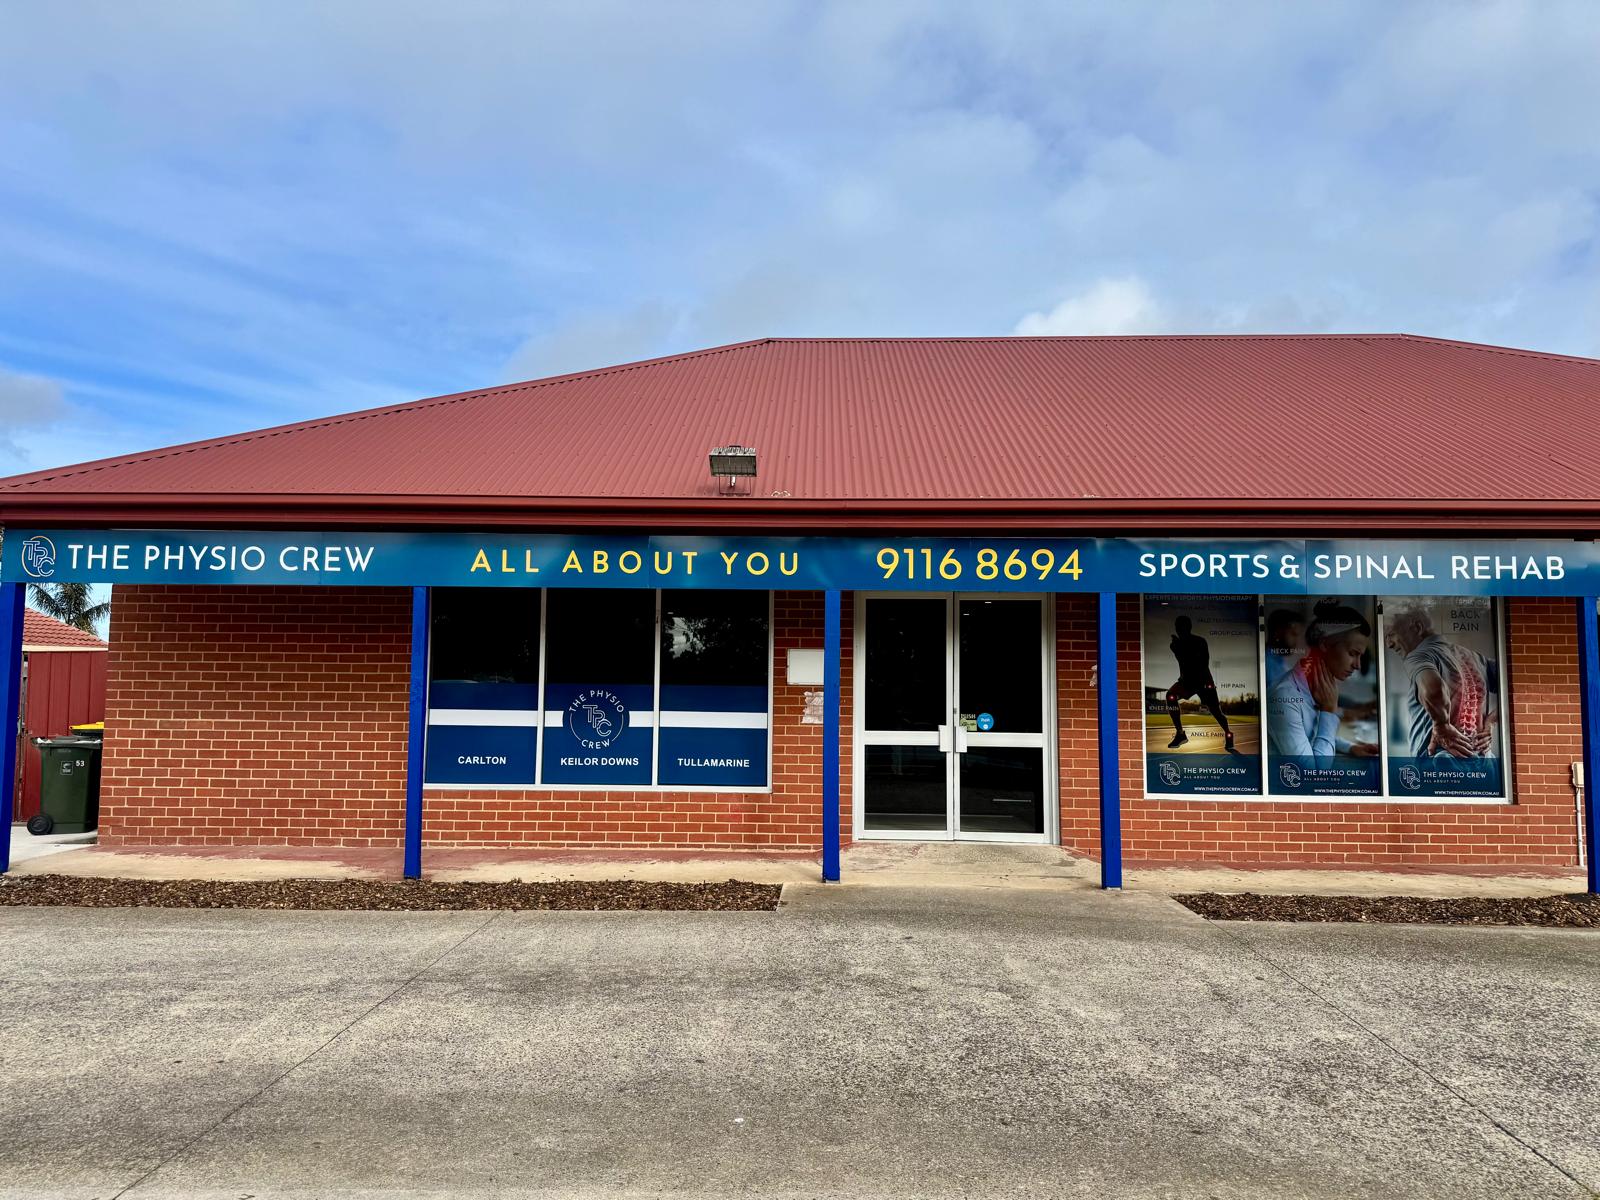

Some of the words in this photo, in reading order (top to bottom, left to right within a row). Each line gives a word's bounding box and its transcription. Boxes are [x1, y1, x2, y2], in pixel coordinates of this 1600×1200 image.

[68, 544, 130, 570] THE
[144, 545, 266, 572] PHYSIO
[279, 546, 375, 572] CREW
[470, 548, 540, 574] ALL
[562, 550, 698, 575] ABOUT
[720, 552, 798, 576] YOU
[876, 548, 962, 580] 9116
[975, 548, 1083, 580] 8694
[1138, 552, 1270, 579] SPORTS
[1279, 554, 1300, 579] &
[1313, 554, 1435, 580] SPINAL
[1451, 555, 1566, 580] REHAB
[1450, 610, 1480, 619] BACK
[1453, 622, 1479, 632] PAIN
[568, 693, 587, 712] THE
[590, 689, 624, 712] PHYSIO
[581, 738, 610, 749] CREW
[458, 756, 507, 765] CARLTON
[560, 757, 599, 766] KEILOR
[601, 757, 639, 766] DOWNS
[677, 758, 750, 768] TULLAMARINE
